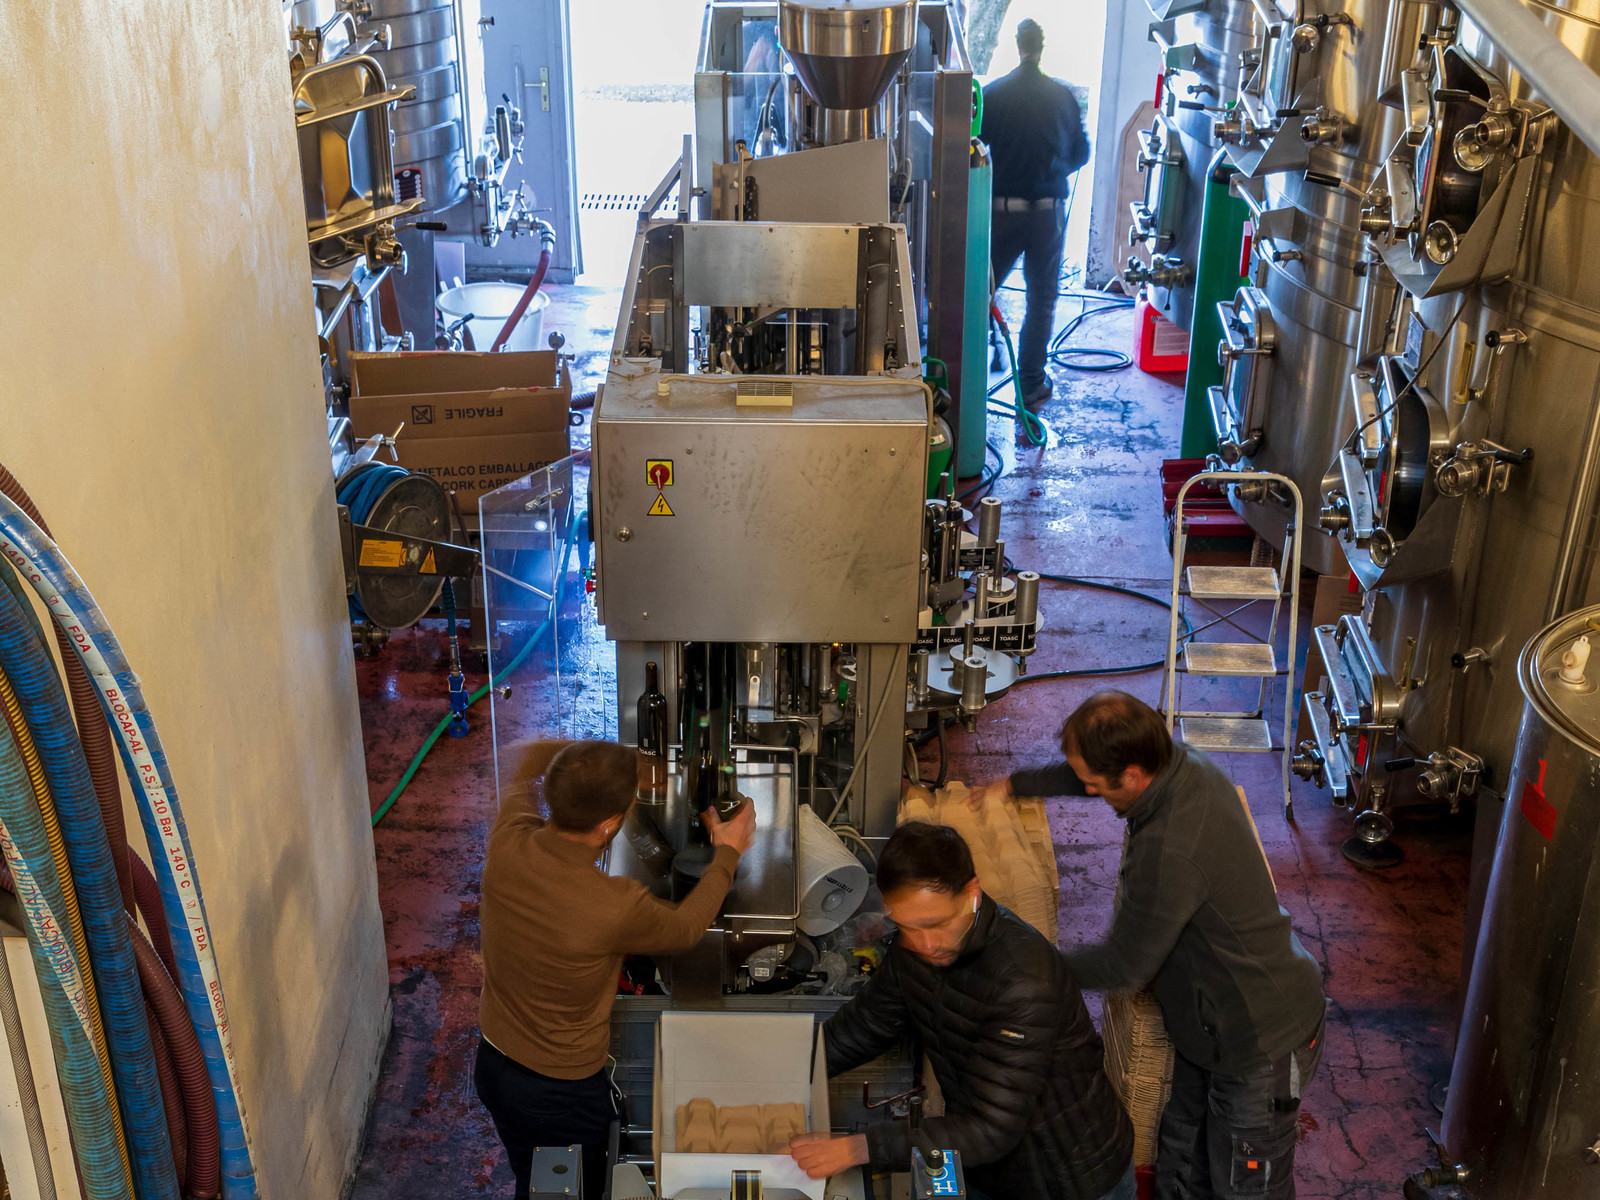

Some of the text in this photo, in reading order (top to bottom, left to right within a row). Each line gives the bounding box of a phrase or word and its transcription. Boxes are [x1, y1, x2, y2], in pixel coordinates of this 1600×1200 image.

[445, 406, 503, 419] FRAGILE
[441, 480, 476, 492] CORK
[68, 625, 92, 653] FDA
[105, 688, 144, 755] BLOCAP-AL
[153, 799, 167, 815] 10
[160, 816, 174, 838] Bar
[194, 927, 208, 951] FDA
